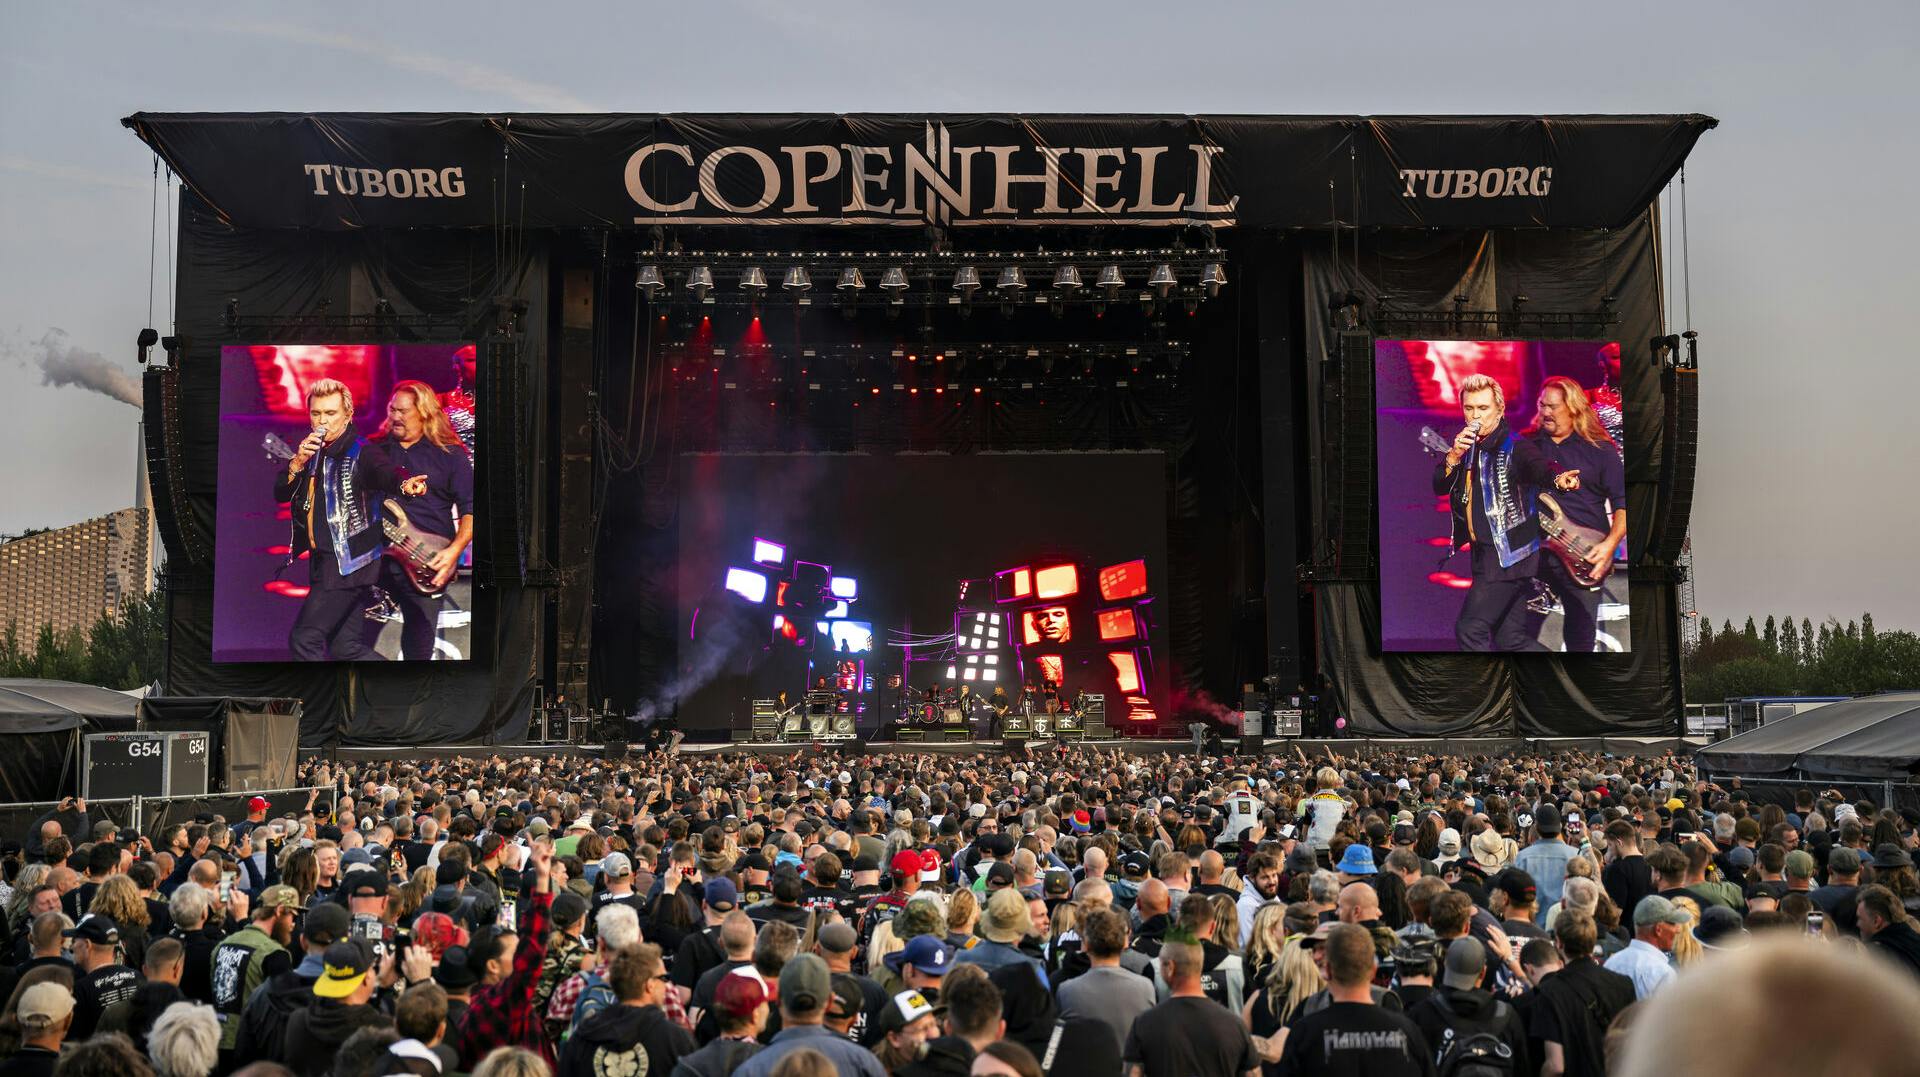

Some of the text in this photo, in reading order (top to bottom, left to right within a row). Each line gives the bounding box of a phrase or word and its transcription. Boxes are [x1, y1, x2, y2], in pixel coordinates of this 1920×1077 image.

[304, 164, 466, 198] TUBORG
[624, 119, 1240, 226] COPENHELL
[1400, 166, 1552, 198] TUBORG
[128, 742, 161, 757] G54
[189, 740, 205, 754] G54
